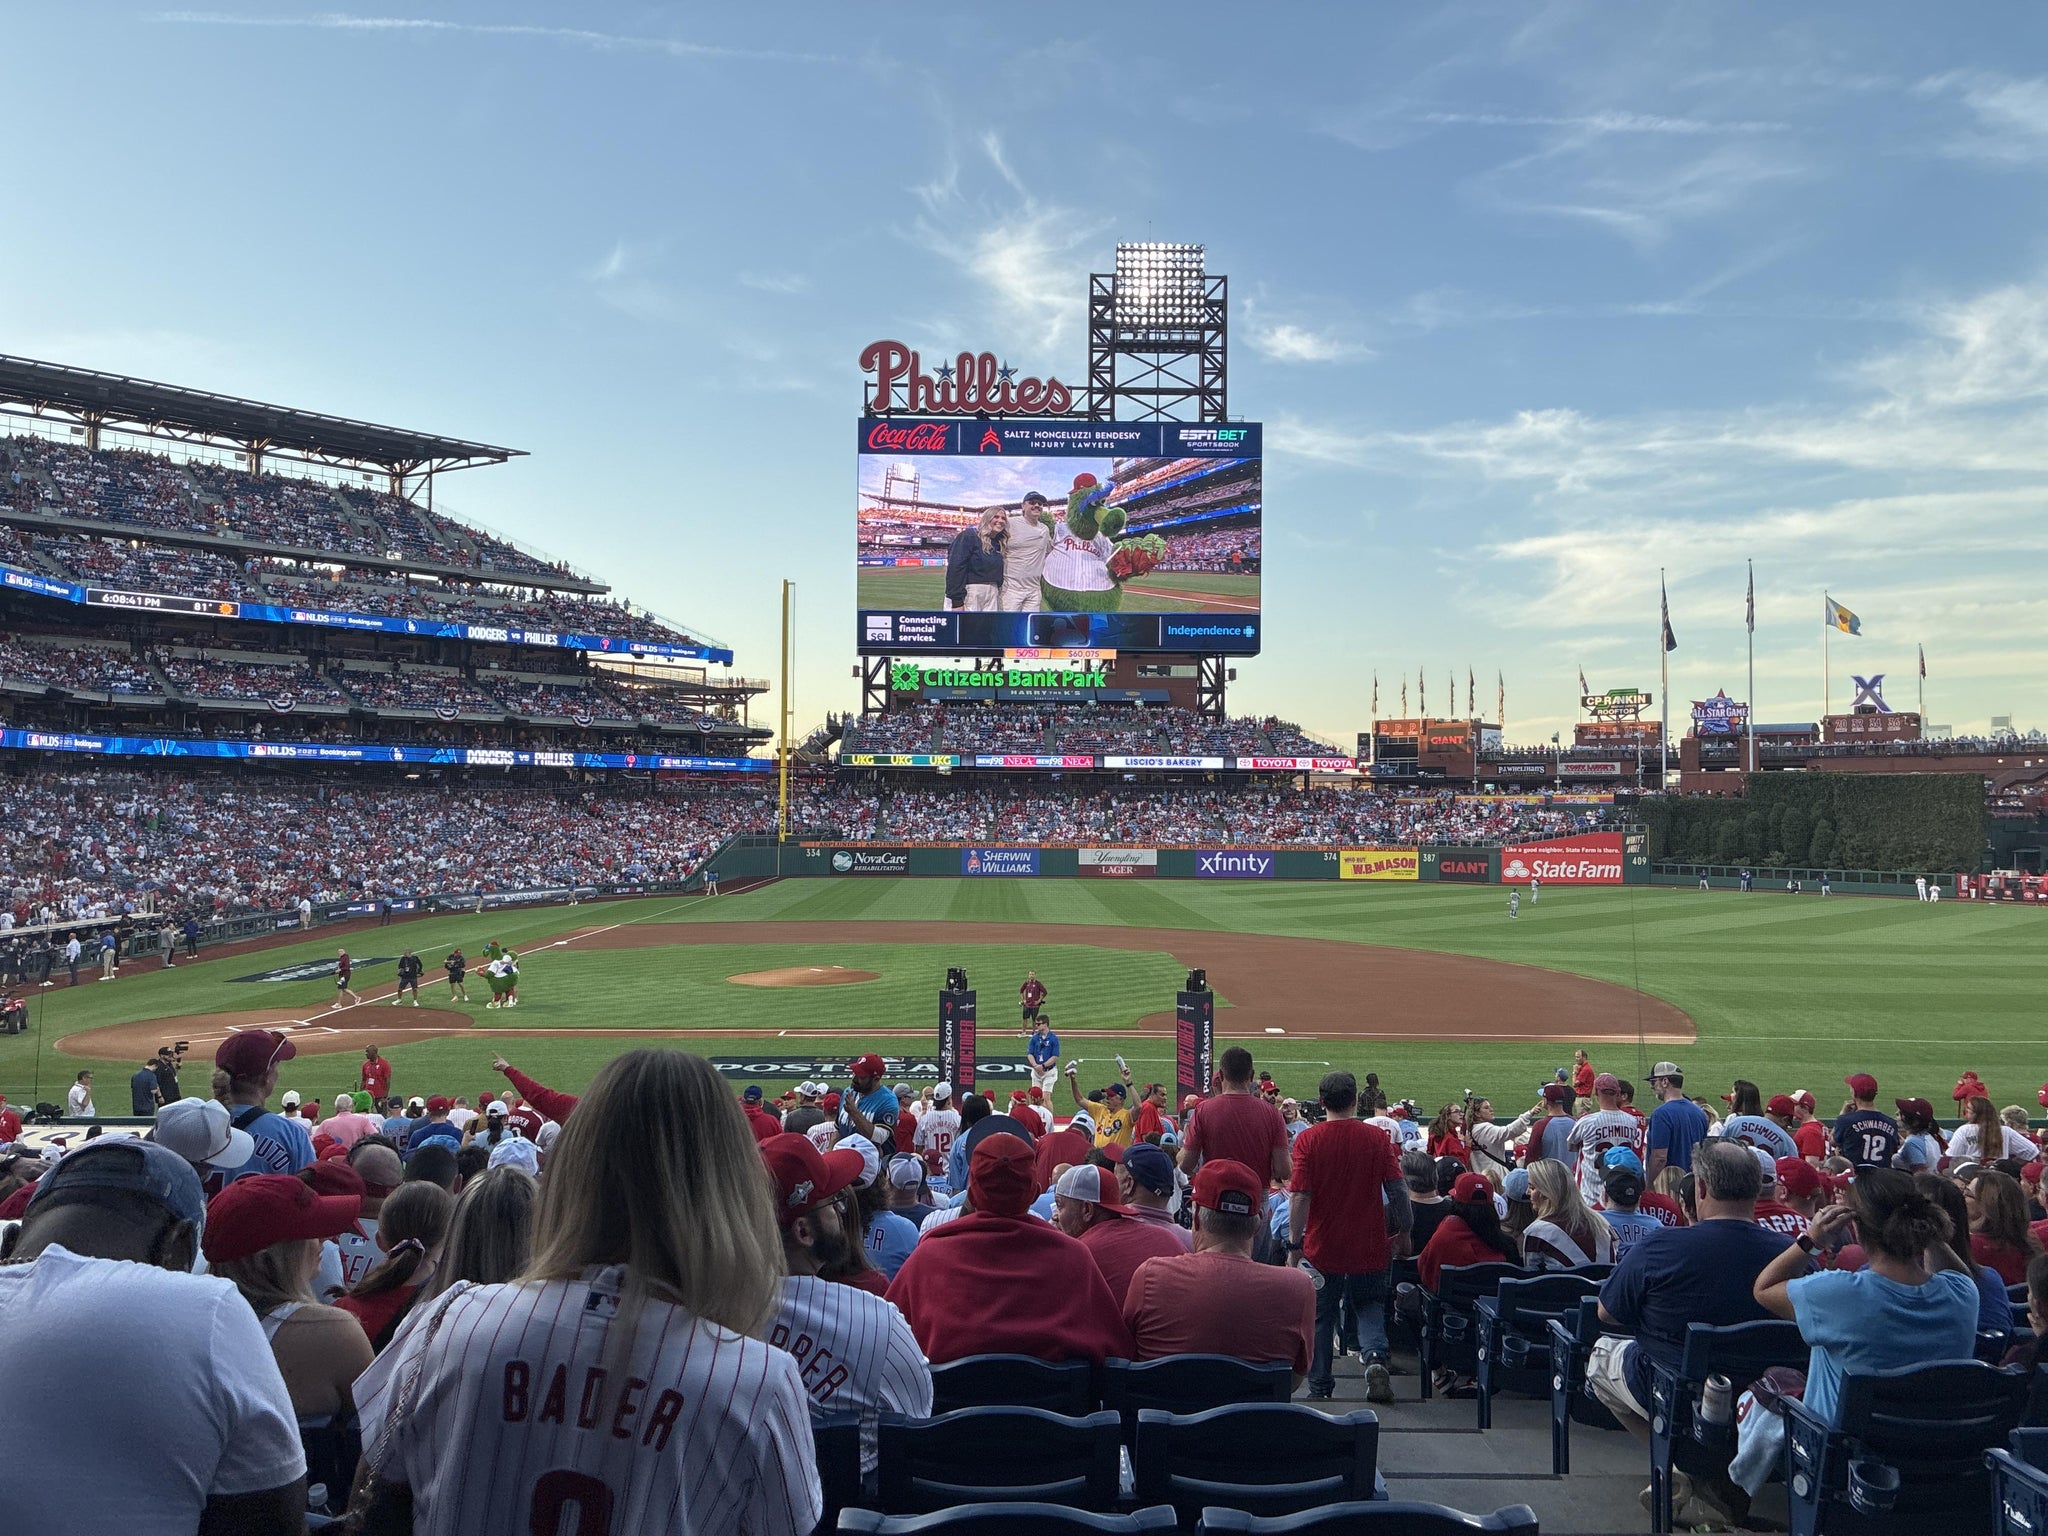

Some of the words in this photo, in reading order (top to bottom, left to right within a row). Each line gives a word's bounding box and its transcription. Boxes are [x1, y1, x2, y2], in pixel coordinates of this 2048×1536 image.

[859, 339, 1072, 414] Phillies
[1004, 430, 1030, 438] SALTZ
[1034, 430, 1091, 438] MONGELUZZI
[1095, 432, 1141, 440] BENDESKY
[1179, 429, 1217, 441] ESPN
[1218, 429, 1247, 441] BET
[16, 575, 32, 588] NLDS
[45, 583, 70, 595] Booking.com
[102, 593, 142, 606] 6:08:41
[144, 598, 160, 607] PM
[306, 613, 329, 623] NLDS
[348, 618, 382, 626] Booking.com
[899, 616, 947, 626] Connecting
[899, 625, 935, 633] financial
[1168, 625, 1241, 638] Independence
[468, 626, 508, 641] DODGERS
[524, 631, 558, 646] PHILLIES
[899, 634, 936, 642] services.
[924, 668, 1004, 687] Citizens
[1008, 668, 1058, 688] Bank
[1062, 670, 1106, 688] Park
[1604, 695, 1646, 705] RANKIN
[1692, 710, 1706, 718] ALL
[1707, 708, 1725, 717] STAR
[1726, 707, 1748, 716] GAME
[1836, 719, 1848, 728] 20
[1851, 718, 1864, 728] 32
[1869, 718, 1882, 728] 34
[1888, 717, 1900, 728] 36
[40, 736, 59, 748] NLDS
[74, 739, 102, 748] Booking.com
[1431, 736, 1464, 744] GIANT
[267, 746, 296, 756] NLDS
[320, 748, 362, 757] Booking.com
[466, 750, 514, 764] DODGERS
[518, 754, 530, 762] vs
[534, 752, 574, 766] PHILLIES
[672, 759, 692, 767] NLDS
[852, 754, 874, 765] UKG
[890, 754, 912, 765] UKG
[929, 754, 952, 766] UKG
[1065, 758, 1091, 766] NECA
[1166, 758, 1202, 766] BAKERY
[1257, 759, 1294, 767] TOYOTA
[1316, 760, 1352, 768] TOYOTA
[806, 848, 820, 857] 334
[854, 852, 907, 864] NovaCare
[983, 850, 1031, 861] SHERWIN
[1094, 850, 1143, 864] Yuengling
[1324, 852, 1337, 861] 374
[1423, 853, 1436, 862] 387
[1200, 852, 1270, 874] xfinity
[1632, 856, 1647, 866] 409
[982, 862, 1033, 873] WILLIAMS.
[1102, 866, 1134, 874] LAGER
[1440, 861, 1488, 874] GIANT
[1532, 860, 1576, 878] State
[1578, 860, 1621, 878] Farm
[960, 1020, 975, 1063] OCTOBER
[1178, 1019, 1195, 1065] OCTOBER
[945, 1020, 953, 1085] OSTSEASON
[960, 1066, 974, 1085] RED
[1178, 1064, 1194, 1088] RED
[508, 1115, 530, 1128] HARPER
[1596, 1125, 1637, 1140] SCHMIDT
[1741, 1122, 1784, 1146] SCHMIDT
[1852, 1120, 1894, 1137] SCHWARBER
[934, 1132, 951, 1153] 12
[1862, 1134, 1886, 1161] 12
[503, 1360, 685, 1453] BADER
